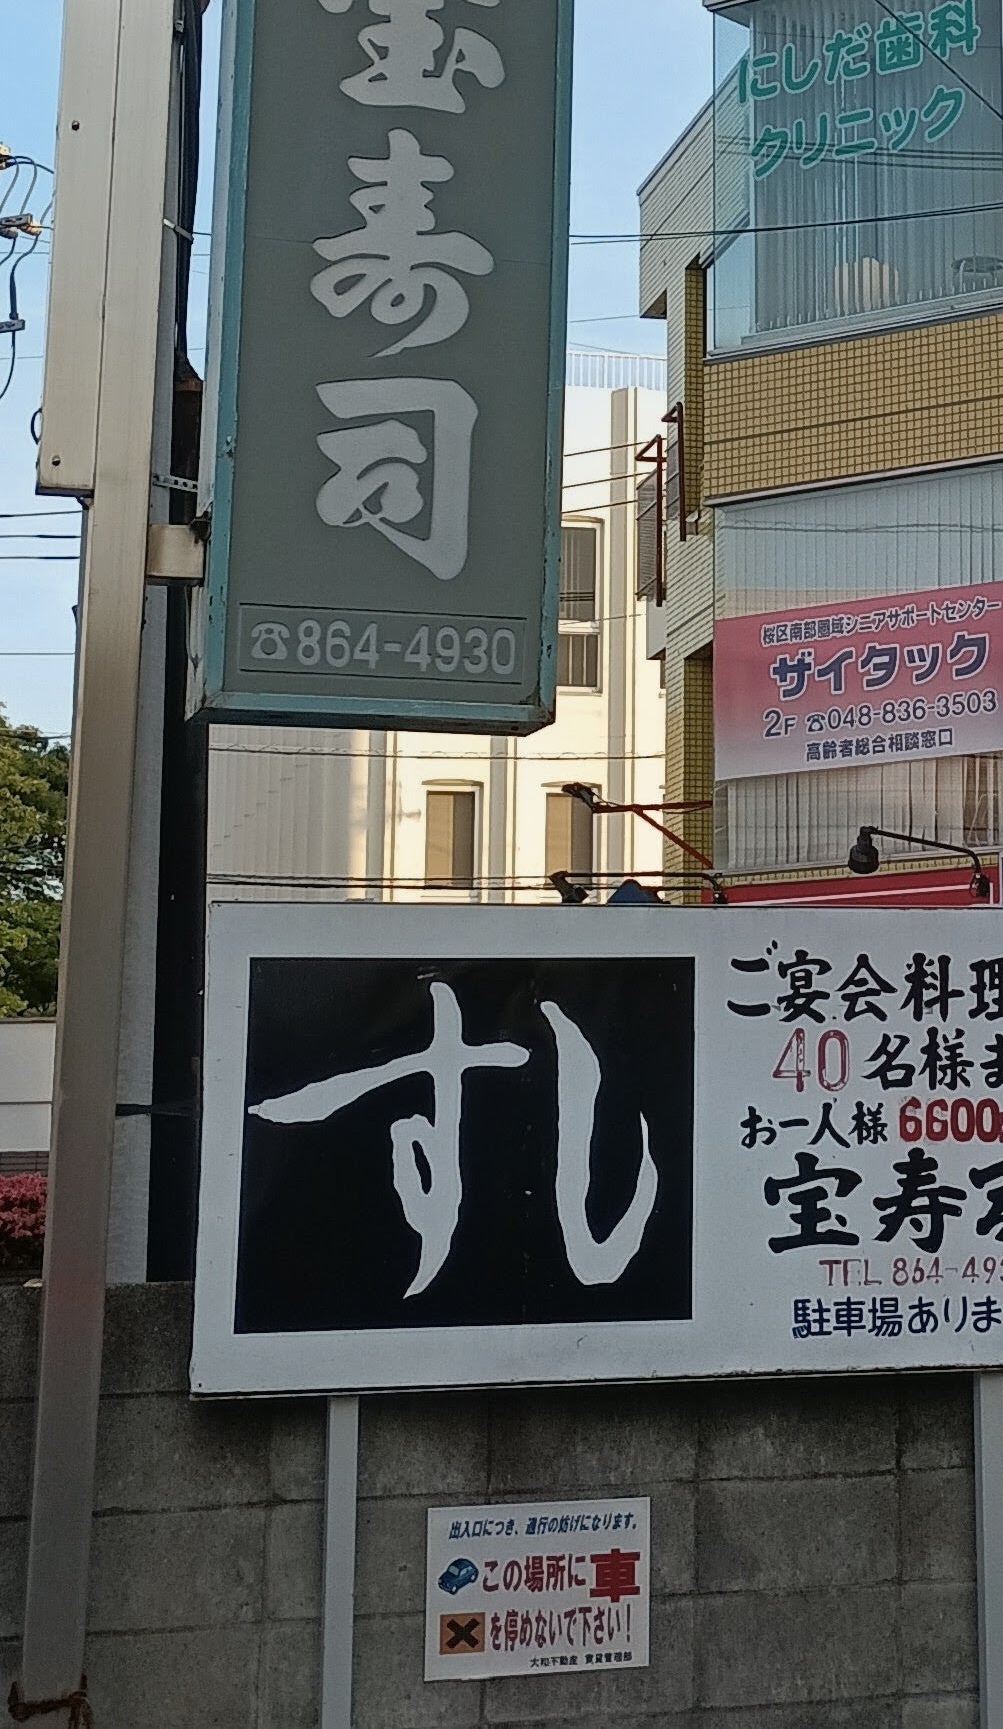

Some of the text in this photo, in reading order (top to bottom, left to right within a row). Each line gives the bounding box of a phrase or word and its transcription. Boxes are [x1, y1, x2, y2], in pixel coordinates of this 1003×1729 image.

[750, 86, 964, 181] クリニック
[295, 619, 518, 675] 864-4930
[772, 633, 989, 701] ザイタック
[763, 689, 998, 738] 2F 048-836-3503
[805, 727, 954, 762] 高齢者総合相談窓口
[247, 981, 659, 1299] すし
[819, 1259, 882, 1287] TEL
[482, 1548, 641, 1603] この場所に車
